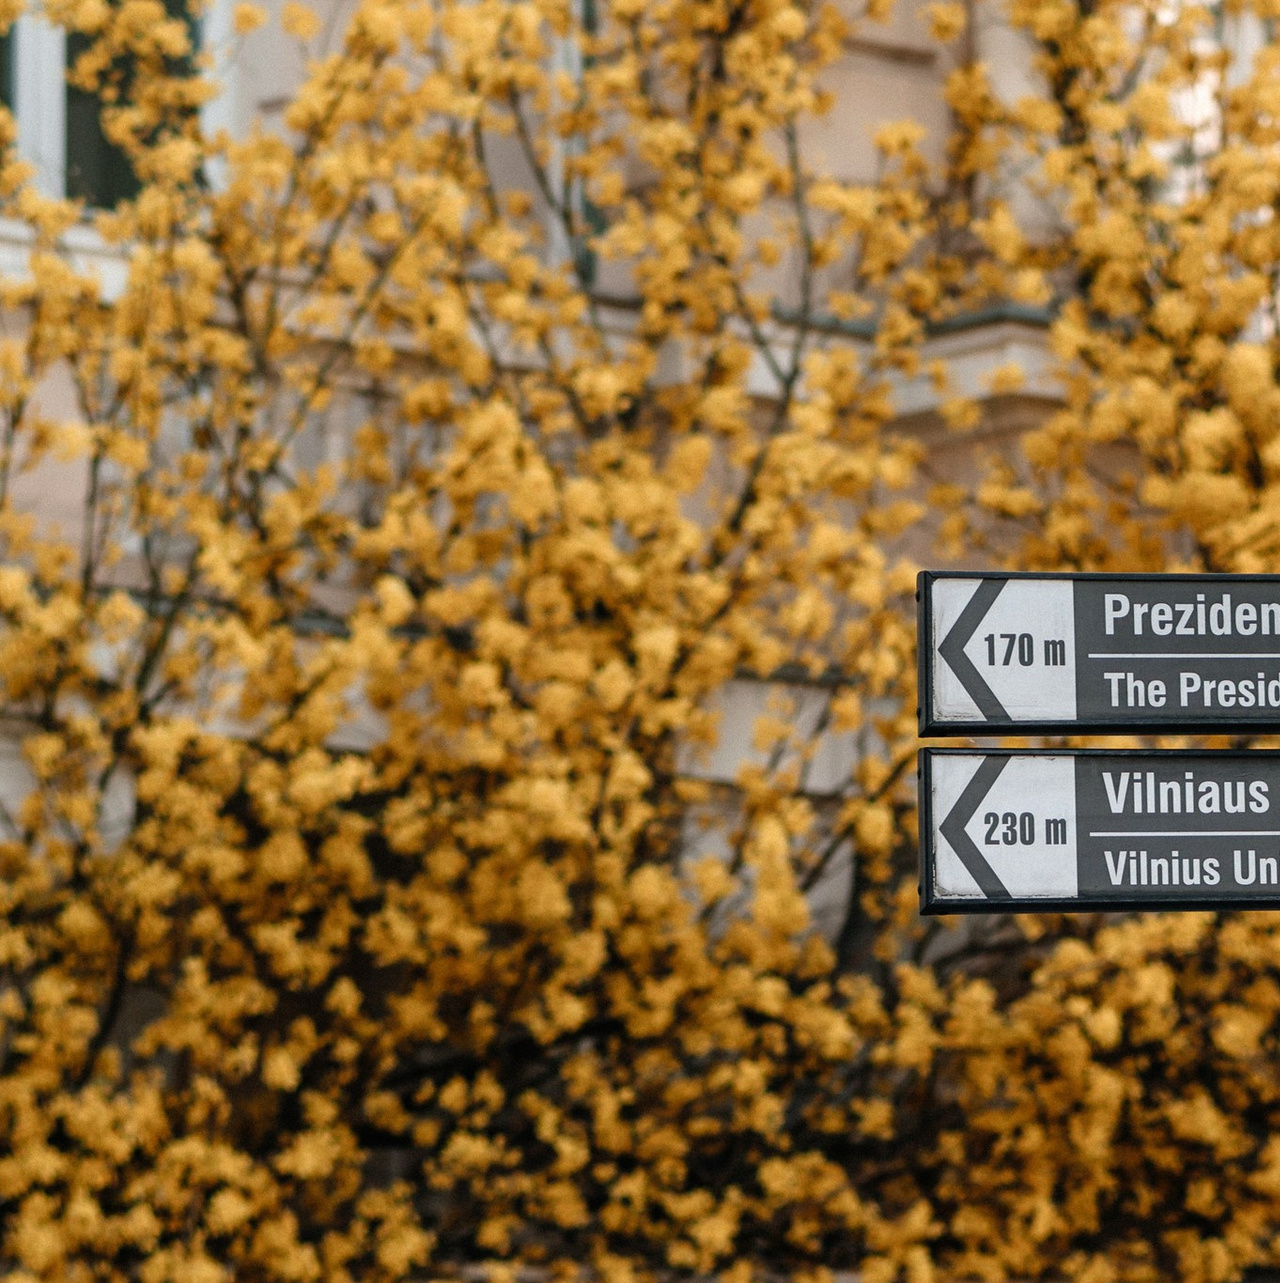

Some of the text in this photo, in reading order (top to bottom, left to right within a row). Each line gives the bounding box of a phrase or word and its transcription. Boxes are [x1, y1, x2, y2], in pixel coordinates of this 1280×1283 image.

[984, 633, 1066, 666] 170 m
[1104, 672, 1166, 707] The
[1102, 771, 1270, 814] Vilniaus
[984, 812, 1067, 845] 230 m
[1104, 850, 1220, 885] Vilnius
